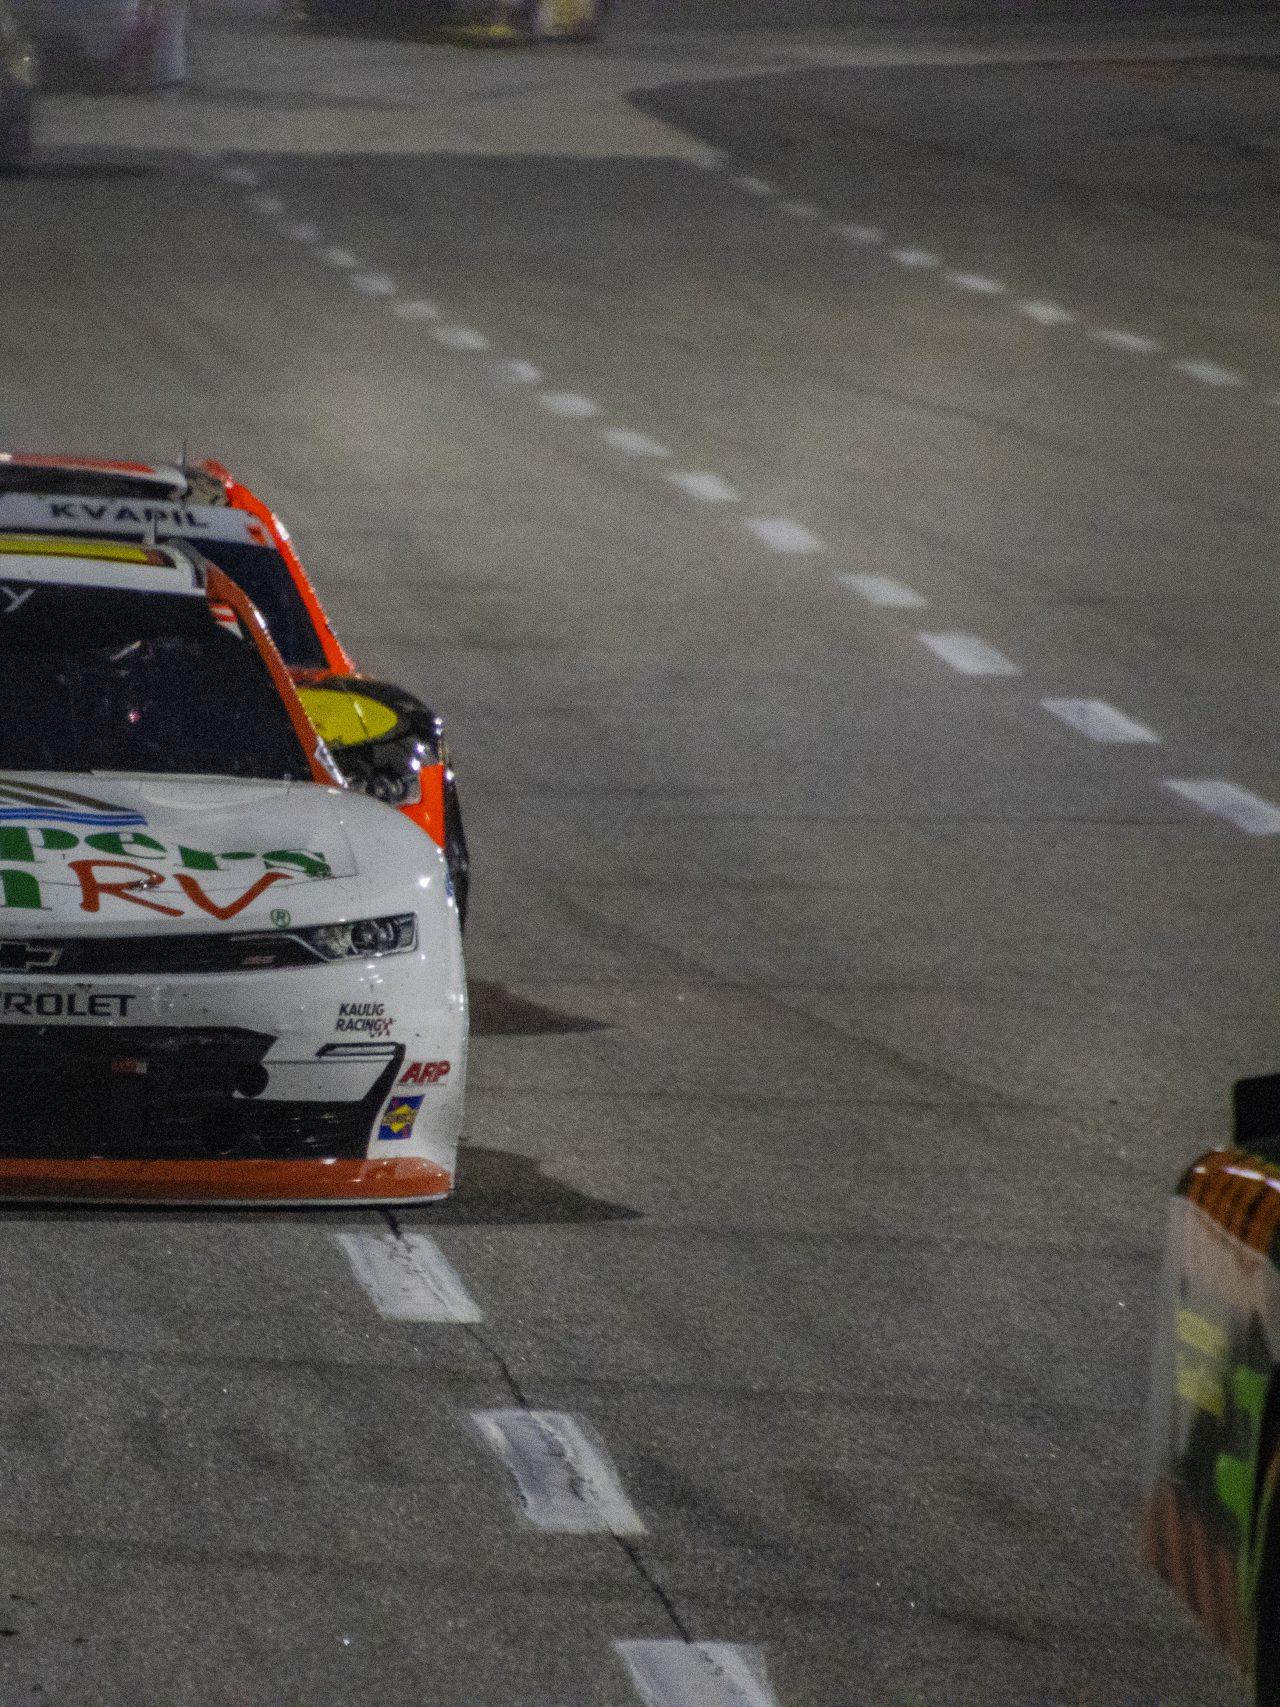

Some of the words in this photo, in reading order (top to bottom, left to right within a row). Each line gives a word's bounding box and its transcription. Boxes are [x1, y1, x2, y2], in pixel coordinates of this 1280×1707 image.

[50, 502, 209, 529] KVAPIL
[68, 860, 294, 919] RV
[339, 1003, 385, 1017] KAULIG
[335, 1019, 384, 1033] RACING
[401, 1060, 450, 1084] ARP
